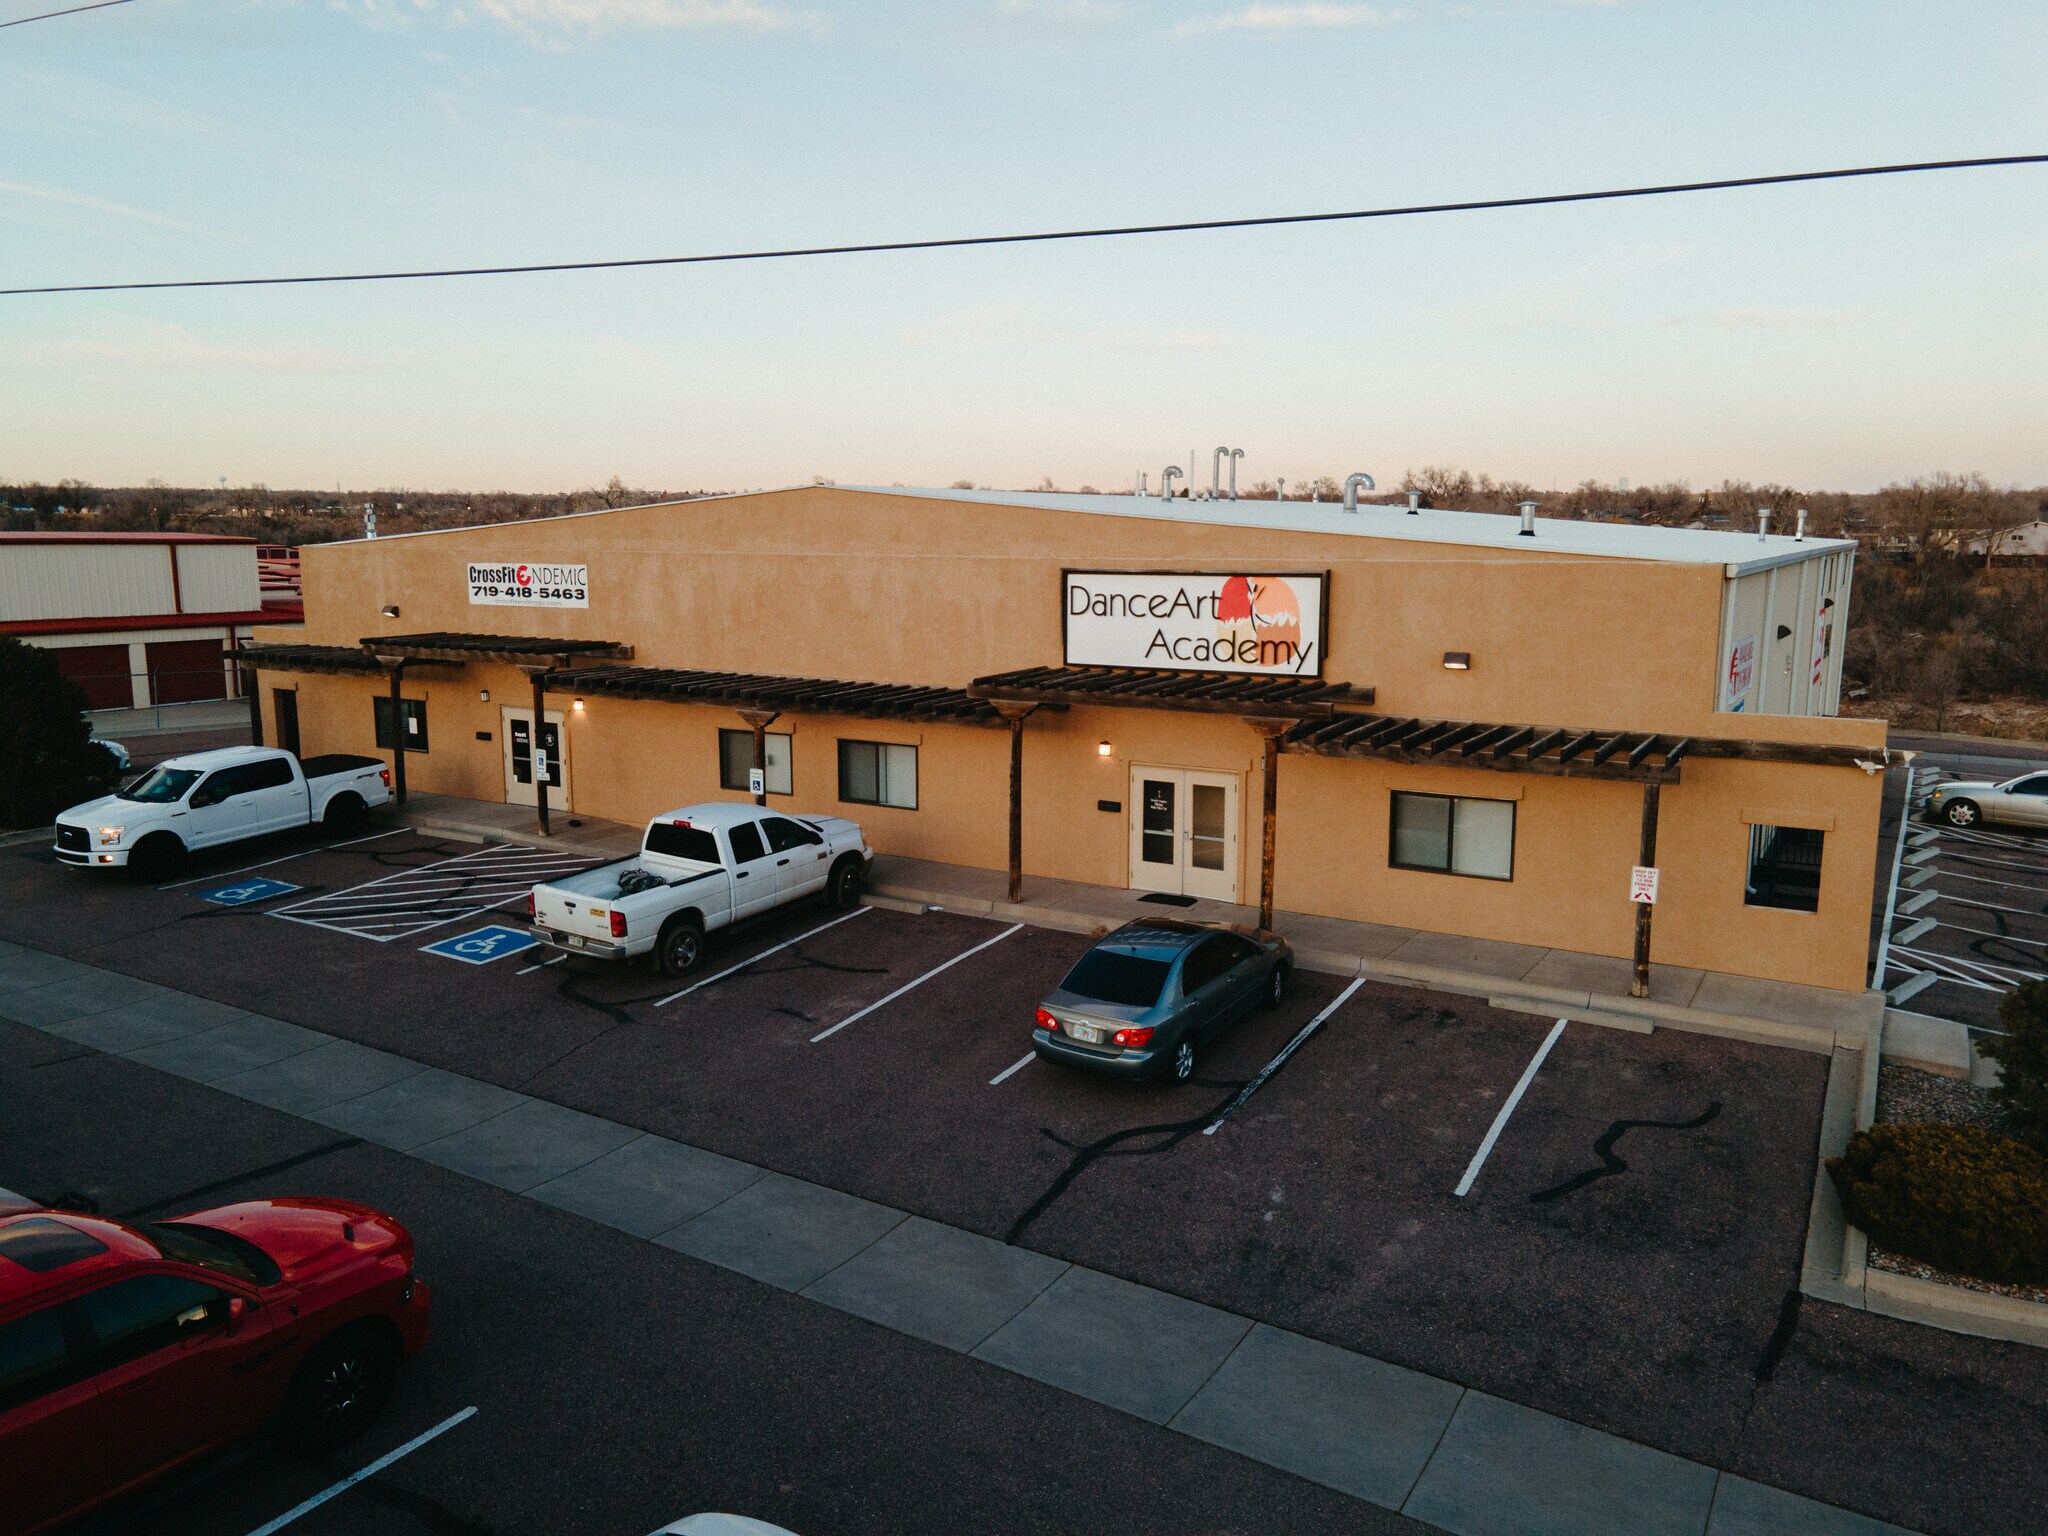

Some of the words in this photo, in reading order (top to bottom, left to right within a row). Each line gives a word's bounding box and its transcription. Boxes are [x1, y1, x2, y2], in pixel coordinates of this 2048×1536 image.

[470, 566, 516, 584] CrossFit
[472, 586, 585, 600] 719-418-5463
[1070, 585, 1222, 620] DanceArt
[1145, 628, 1313, 673] Academy
